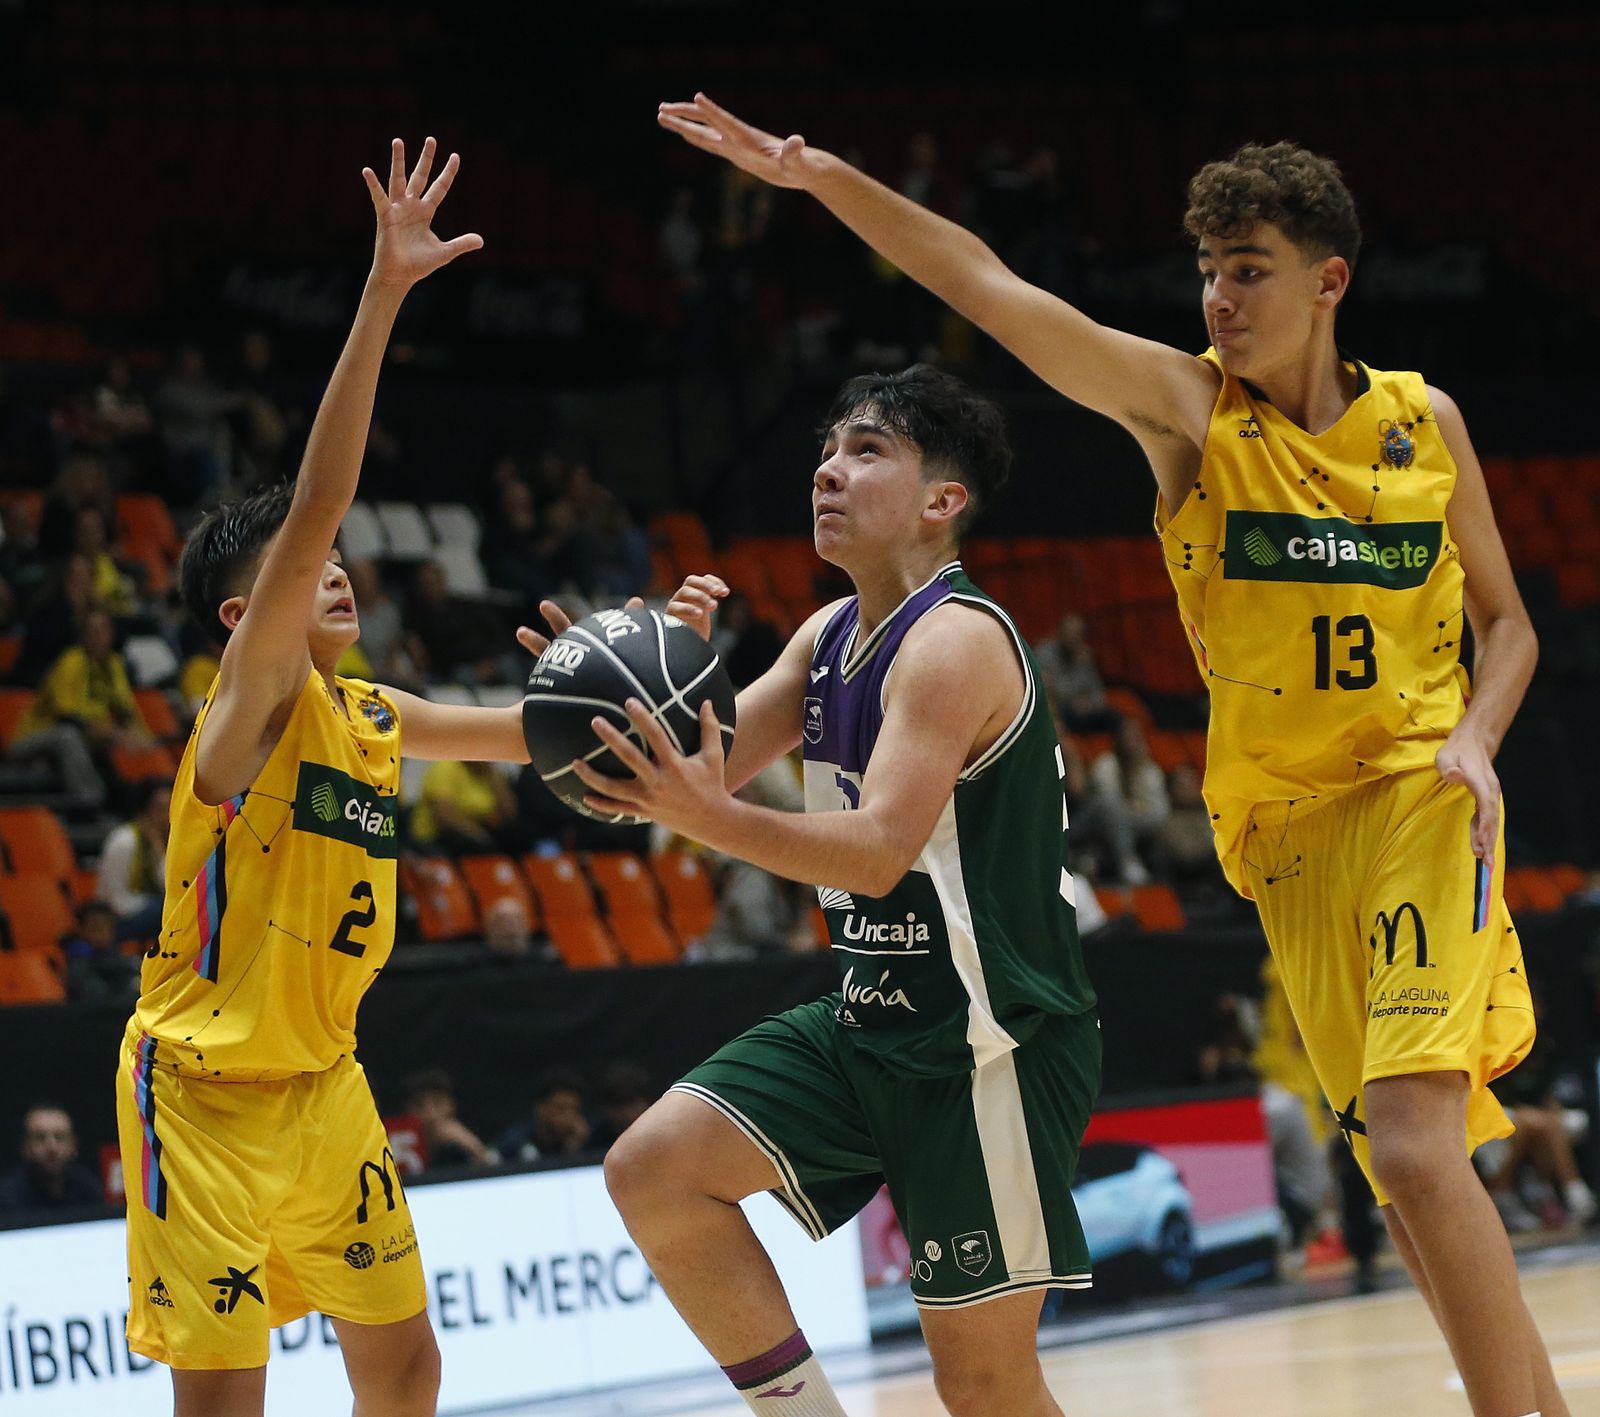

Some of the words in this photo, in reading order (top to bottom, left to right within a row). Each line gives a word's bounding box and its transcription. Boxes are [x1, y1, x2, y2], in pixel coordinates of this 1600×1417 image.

[1287, 532, 1429, 569] cajasiete
[1311, 613, 1378, 691] 13
[329, 880, 376, 958] 2
[843, 912, 930, 950] Uncaja
[1391, 987, 1450, 1003] LAGUNA
[1412, 1005, 1439, 1016] para
[1441, 1006, 1449, 1016] ti
[502, 1243, 658, 1323] MERC
